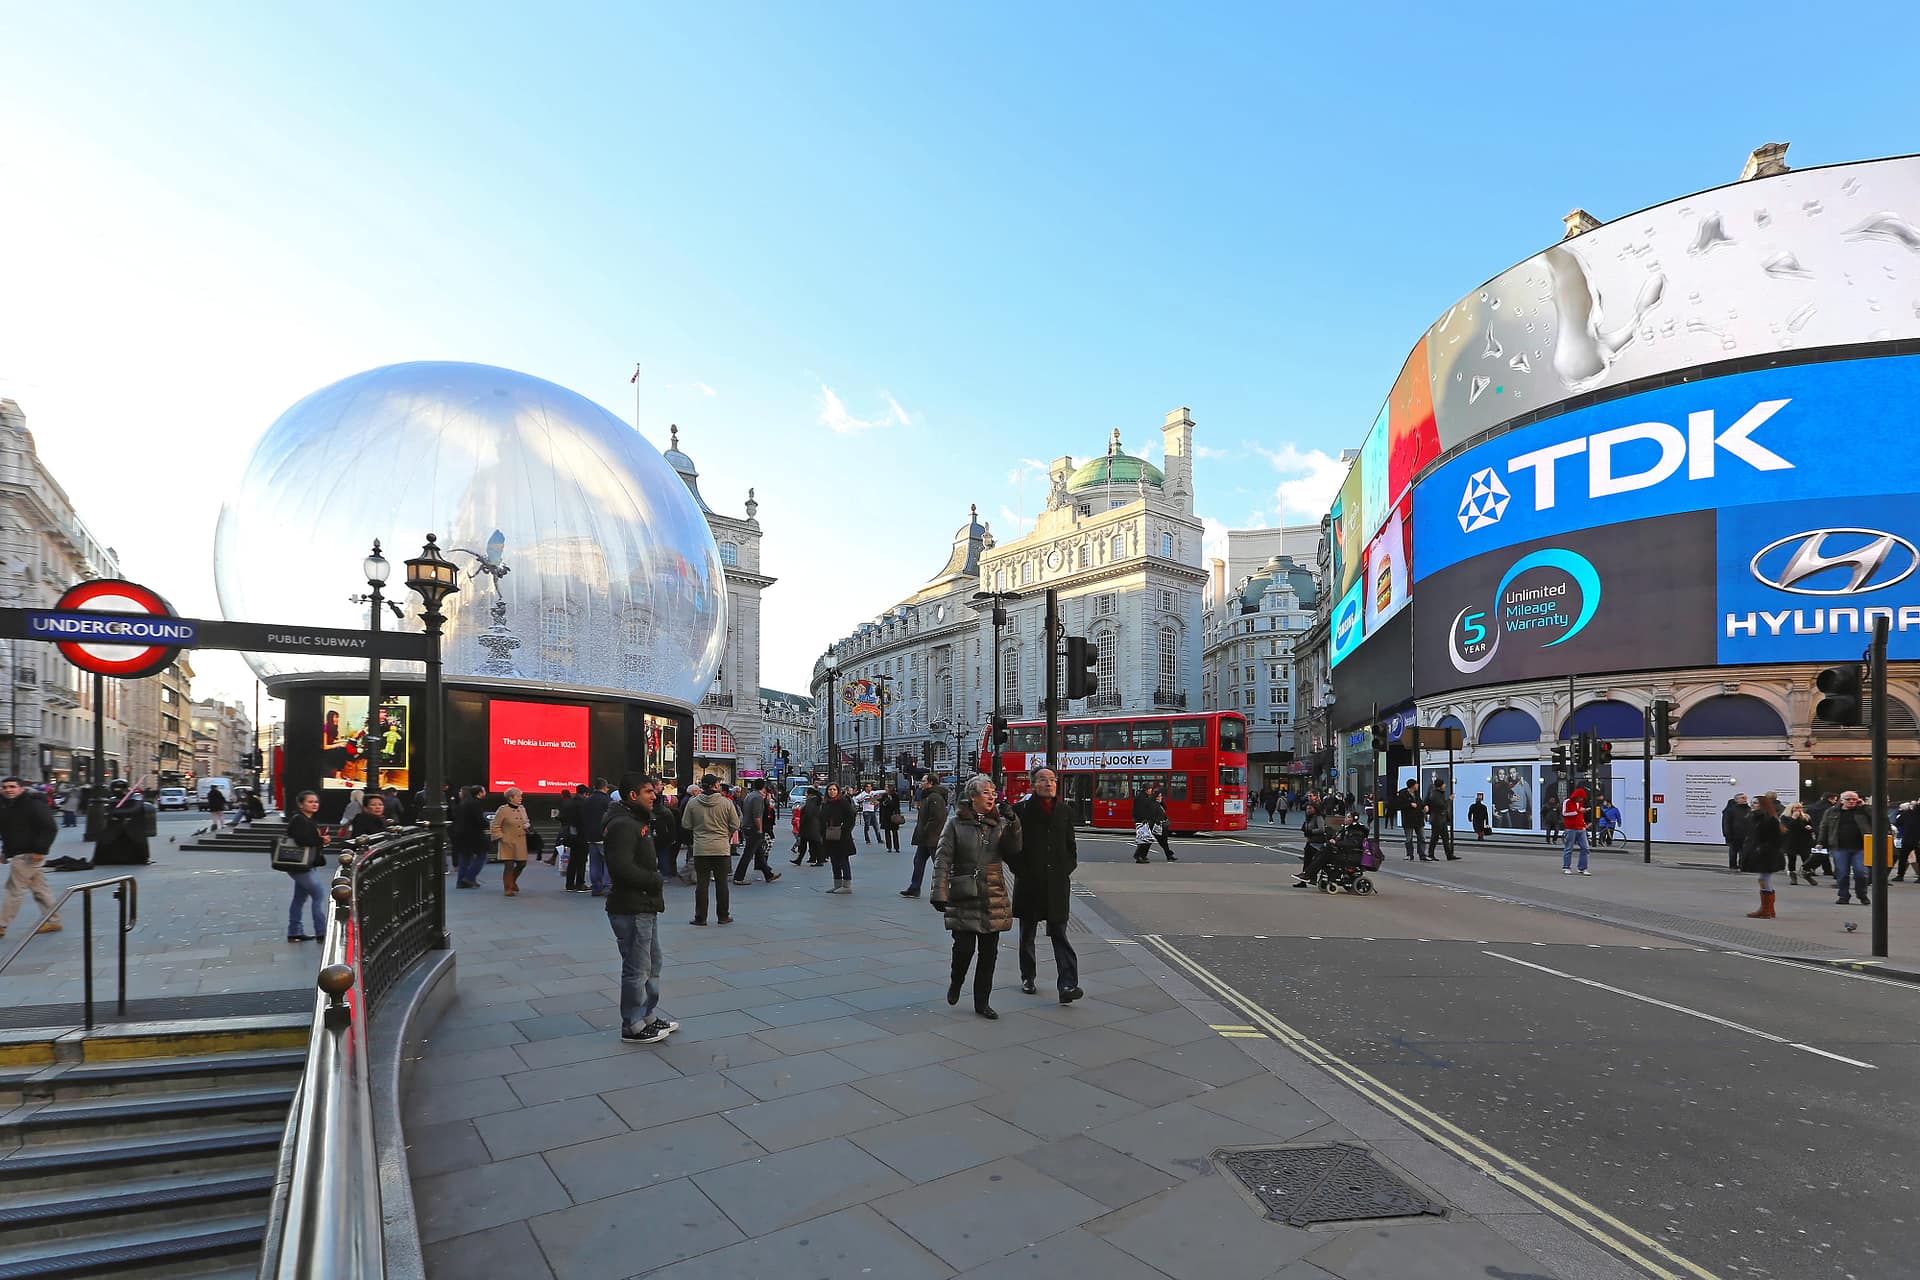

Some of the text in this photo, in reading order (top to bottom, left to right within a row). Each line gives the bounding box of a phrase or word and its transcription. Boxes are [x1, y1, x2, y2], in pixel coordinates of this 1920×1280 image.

[1508, 398, 1796, 512] TDK
[1506, 582, 1566, 604] Unlimited
[1506, 601, 1556, 619] Mileage
[32, 617, 194, 639] UNDERGROUND
[1464, 611, 1487, 645] 5
[1506, 614, 1569, 632] Warranty
[267, 633, 367, 648] PUBLIC SUBWAY
[1464, 643, 1486, 655] YEAR
[503, 738, 516, 746] The
[517, 739, 538, 747] Nokia
[1068, 756, 1101, 766] YOU'RE
[1107, 755, 1150, 765] JOCKEY
